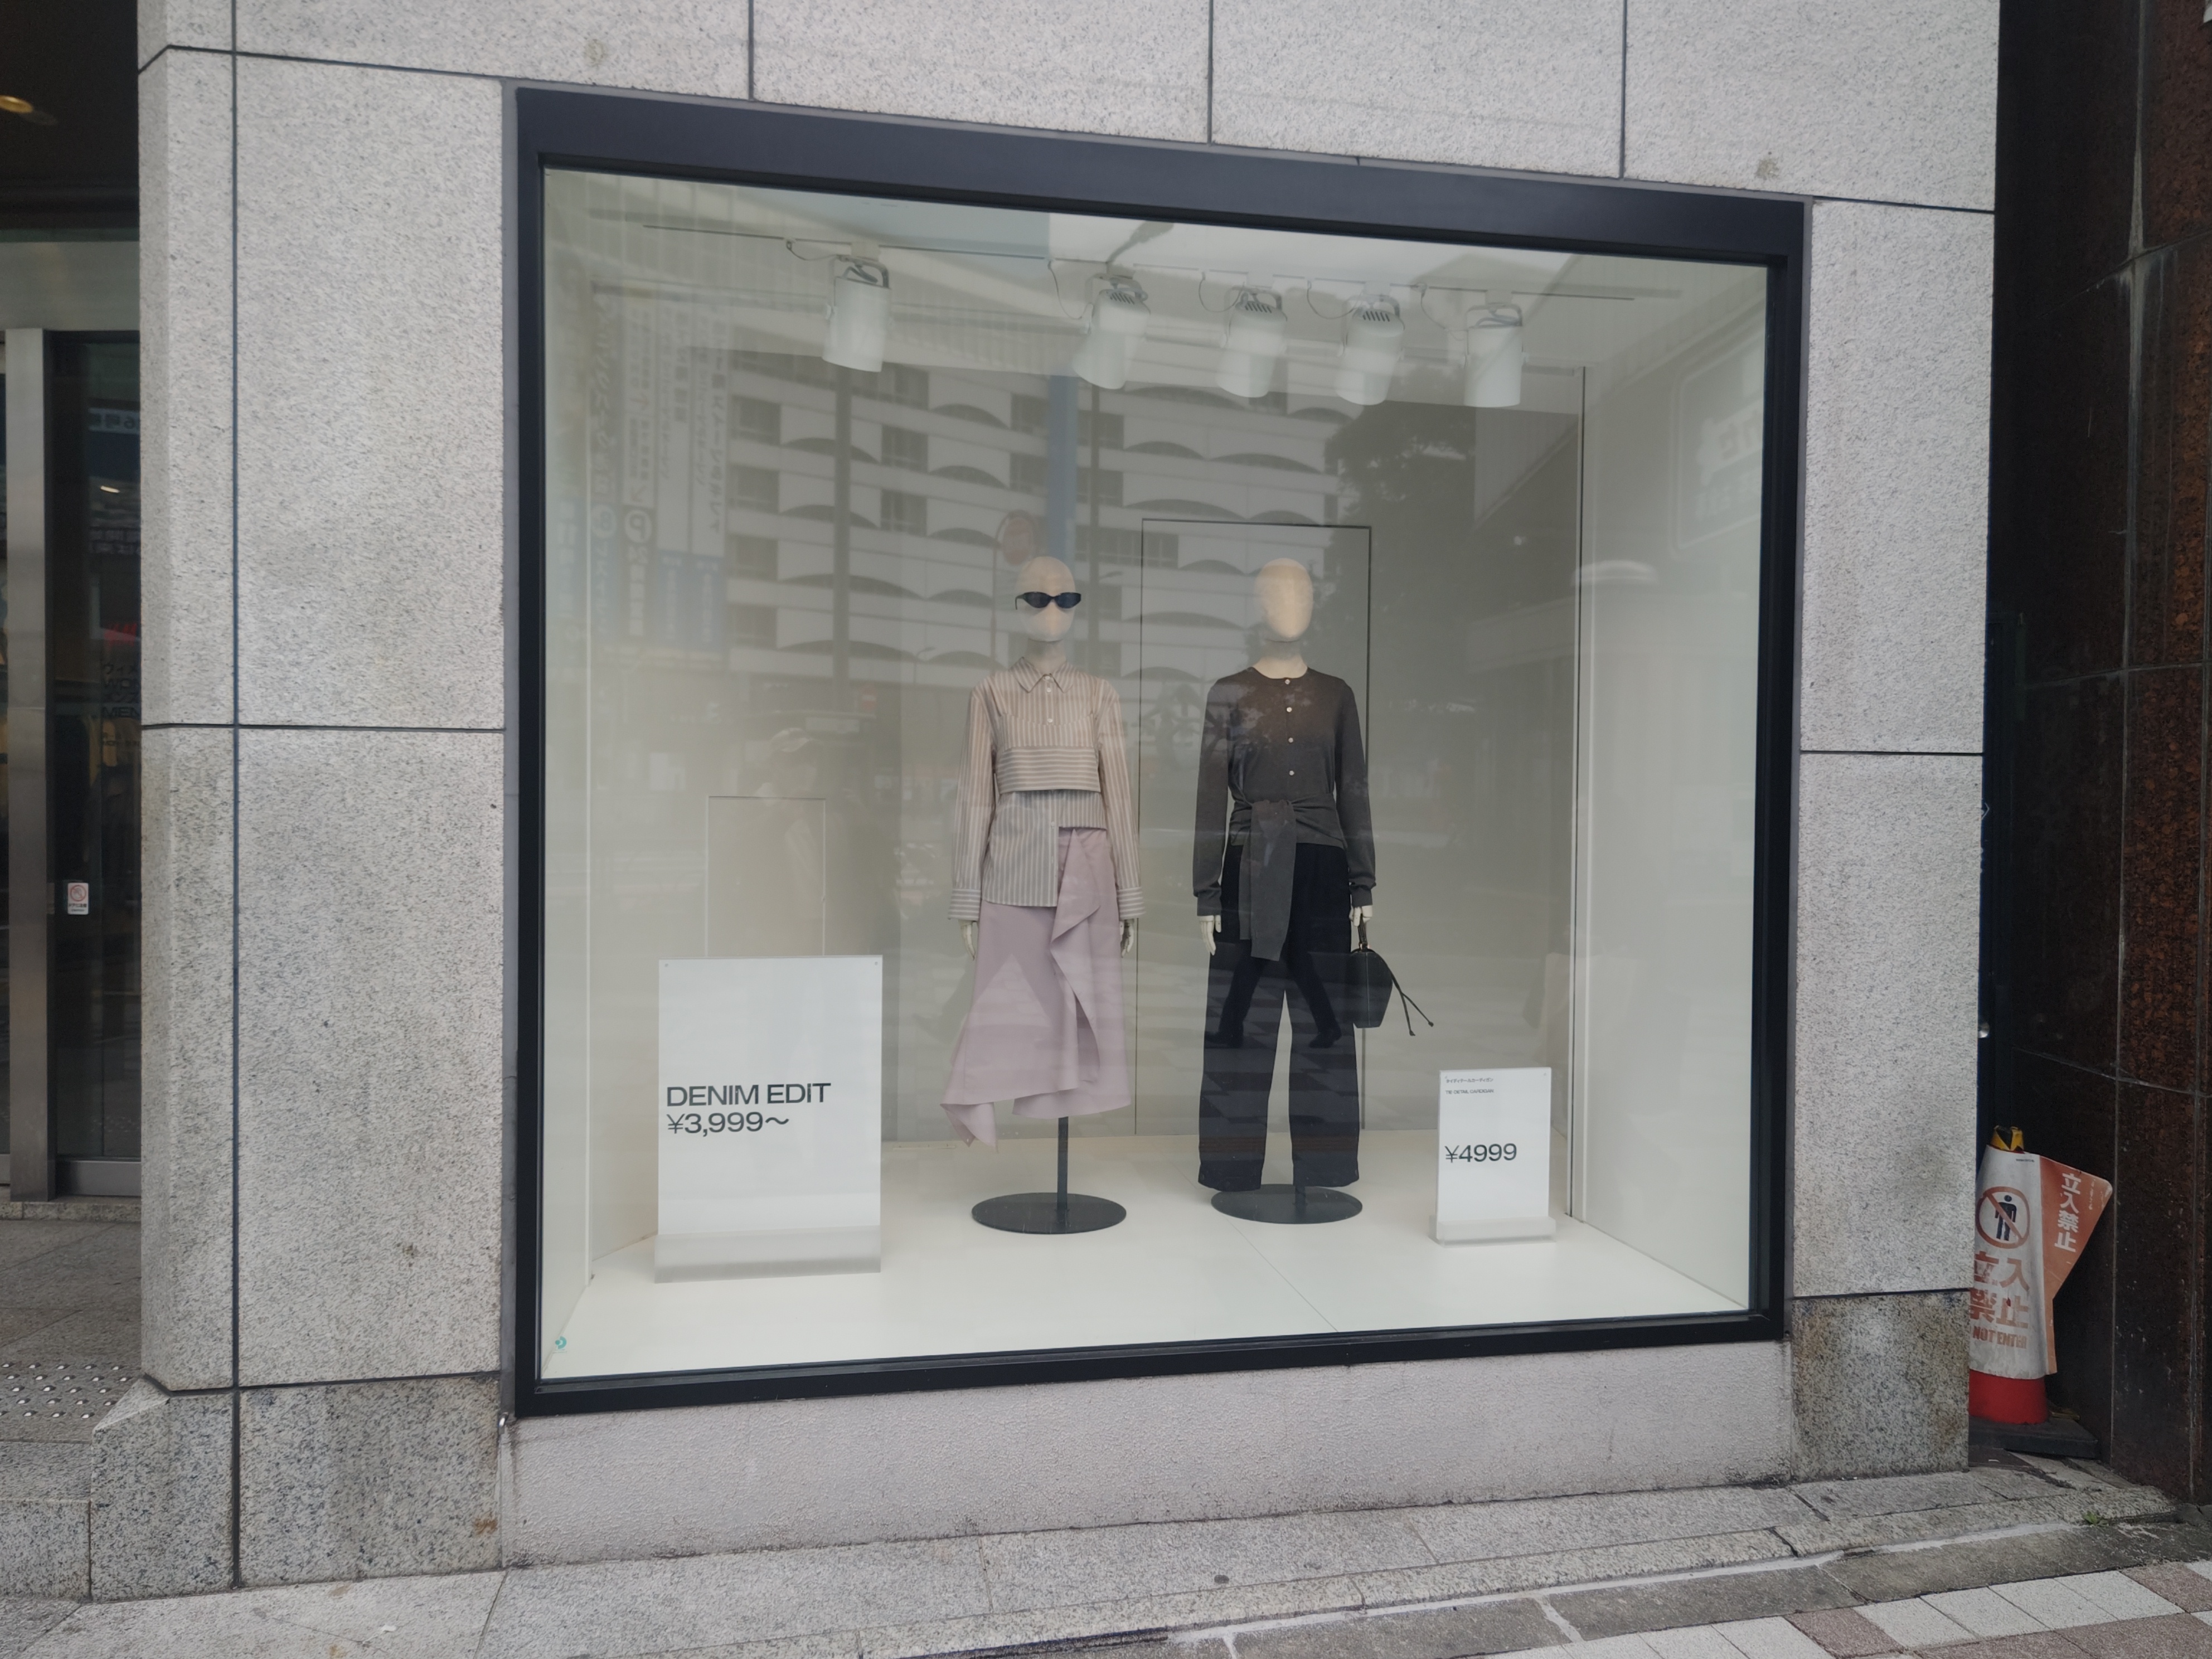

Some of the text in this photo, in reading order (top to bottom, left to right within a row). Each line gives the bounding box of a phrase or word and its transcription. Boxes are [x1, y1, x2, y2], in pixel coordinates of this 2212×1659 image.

[667, 1083, 831, 1107] DENIM EDIT
[1444, 1143, 1517, 1163] ¥4999
[2054, 1172, 2082, 1253] 立入禁止
[1973, 1325, 1997, 1343] NOT
